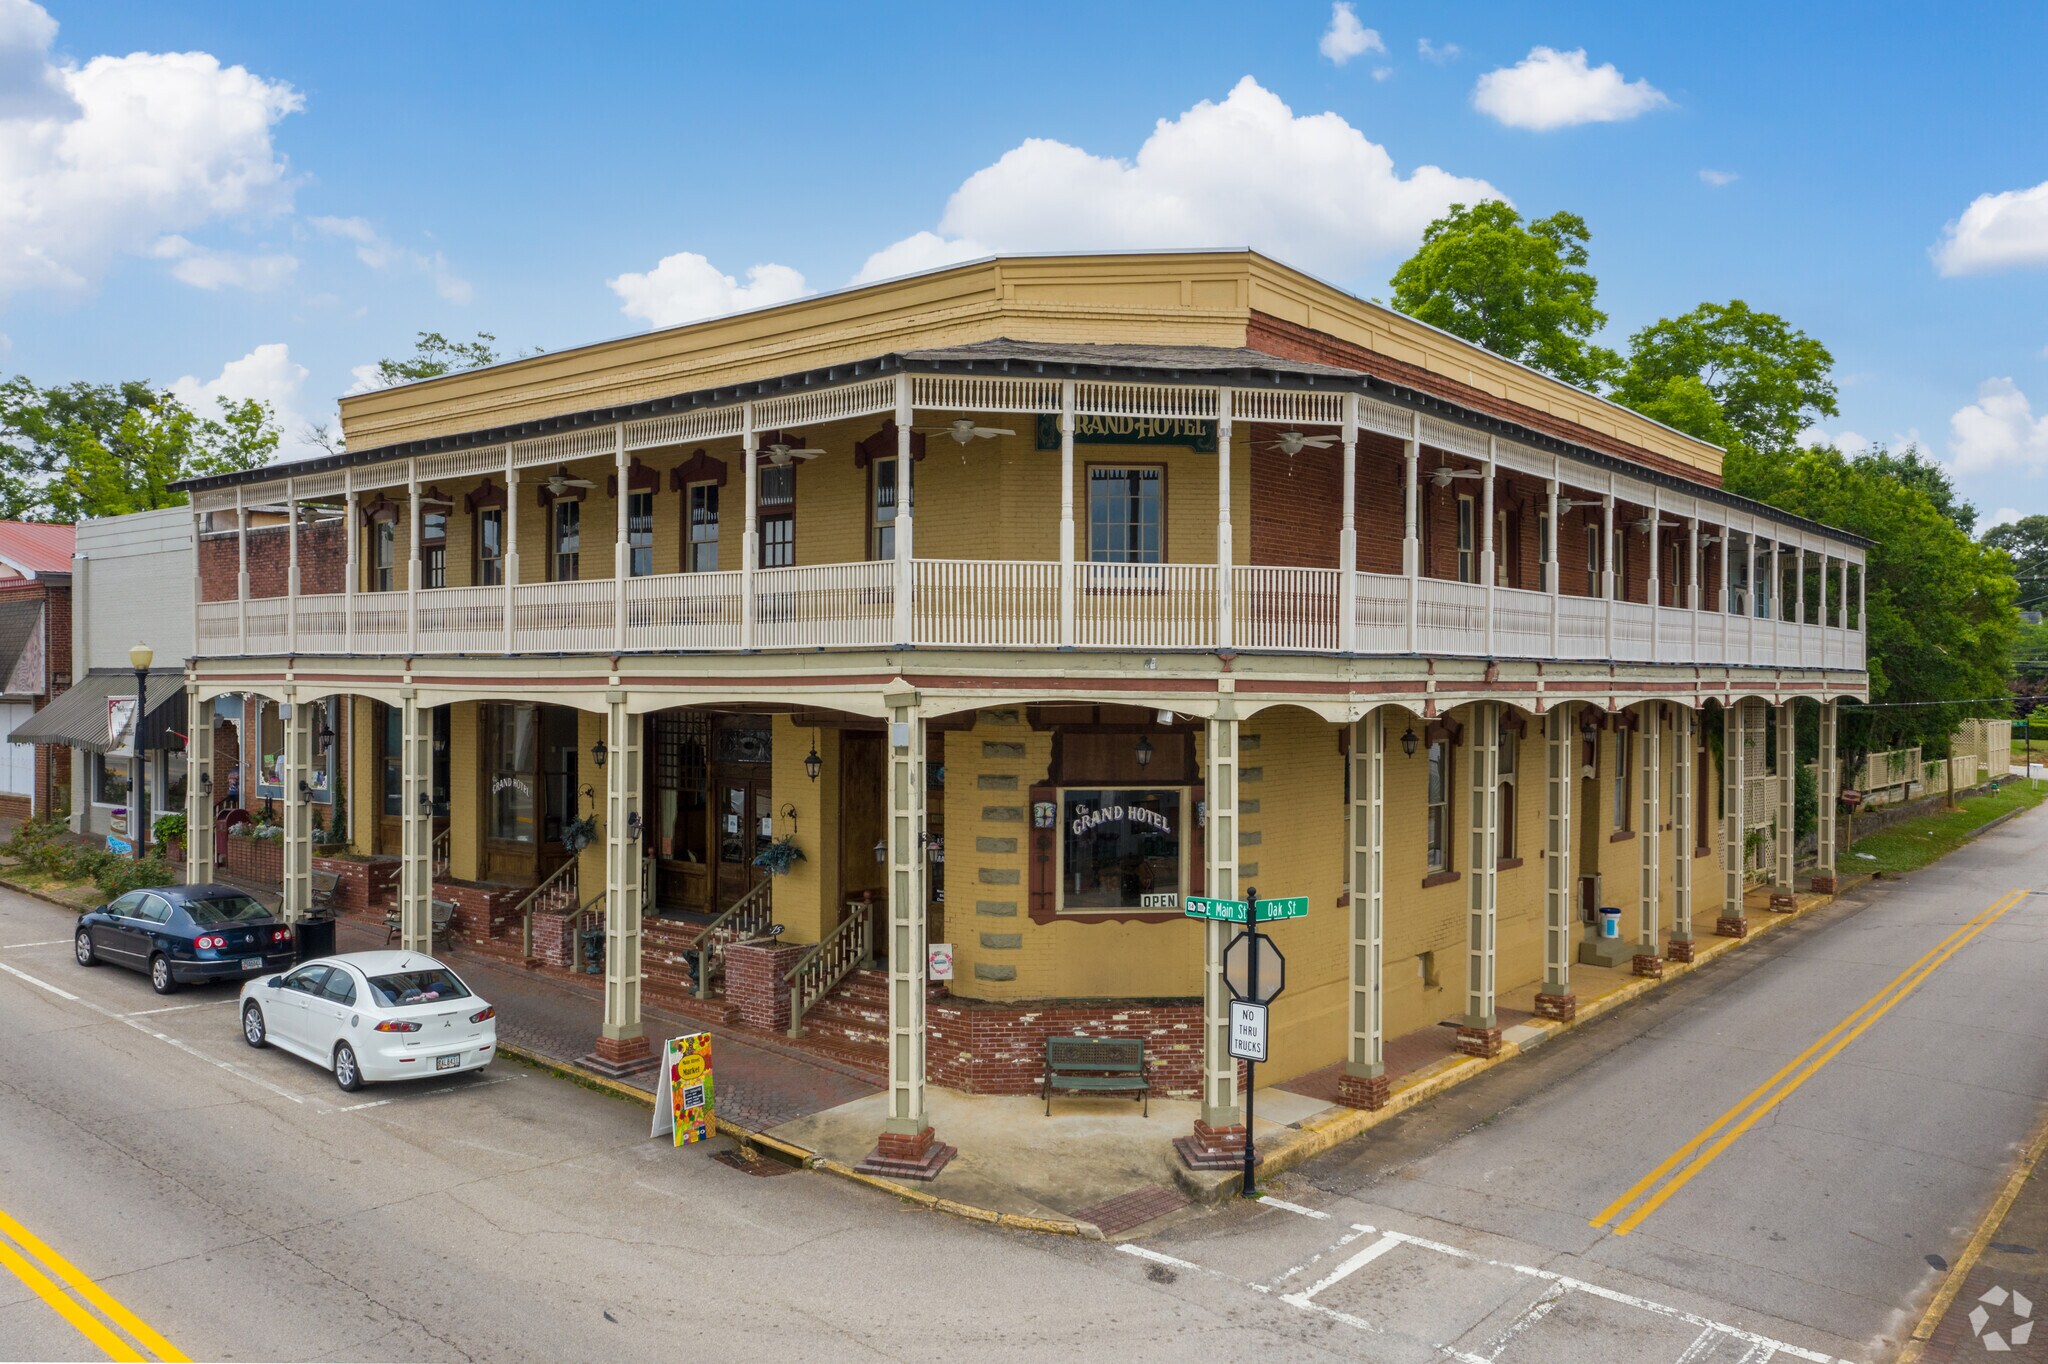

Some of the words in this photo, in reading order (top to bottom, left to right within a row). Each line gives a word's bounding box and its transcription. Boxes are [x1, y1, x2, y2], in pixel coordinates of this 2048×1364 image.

[1134, 418, 1207, 439] HOTEL
[492, 777, 512, 794] GRAND
[512, 778, 529, 797] HOTEL
[1075, 804, 1089, 815] The
[1072, 805, 1124, 835] GRAND
[1128, 806, 1171, 834] HOTEL
[1143, 895, 1176, 907] OPEN
[1206, 901, 1211, 916] E
[1215, 902, 1234, 918] Main
[1237, 904, 1247, 920] St
[1267, 902, 1283, 917] Oak
[1287, 900, 1297, 916] St
[1242, 1009, 1255, 1021] NO
[1239, 1025, 1258, 1037] THRU
[1234, 1039, 1261, 1053] TRUCKS
[682, 1065, 700, 1076] Market
